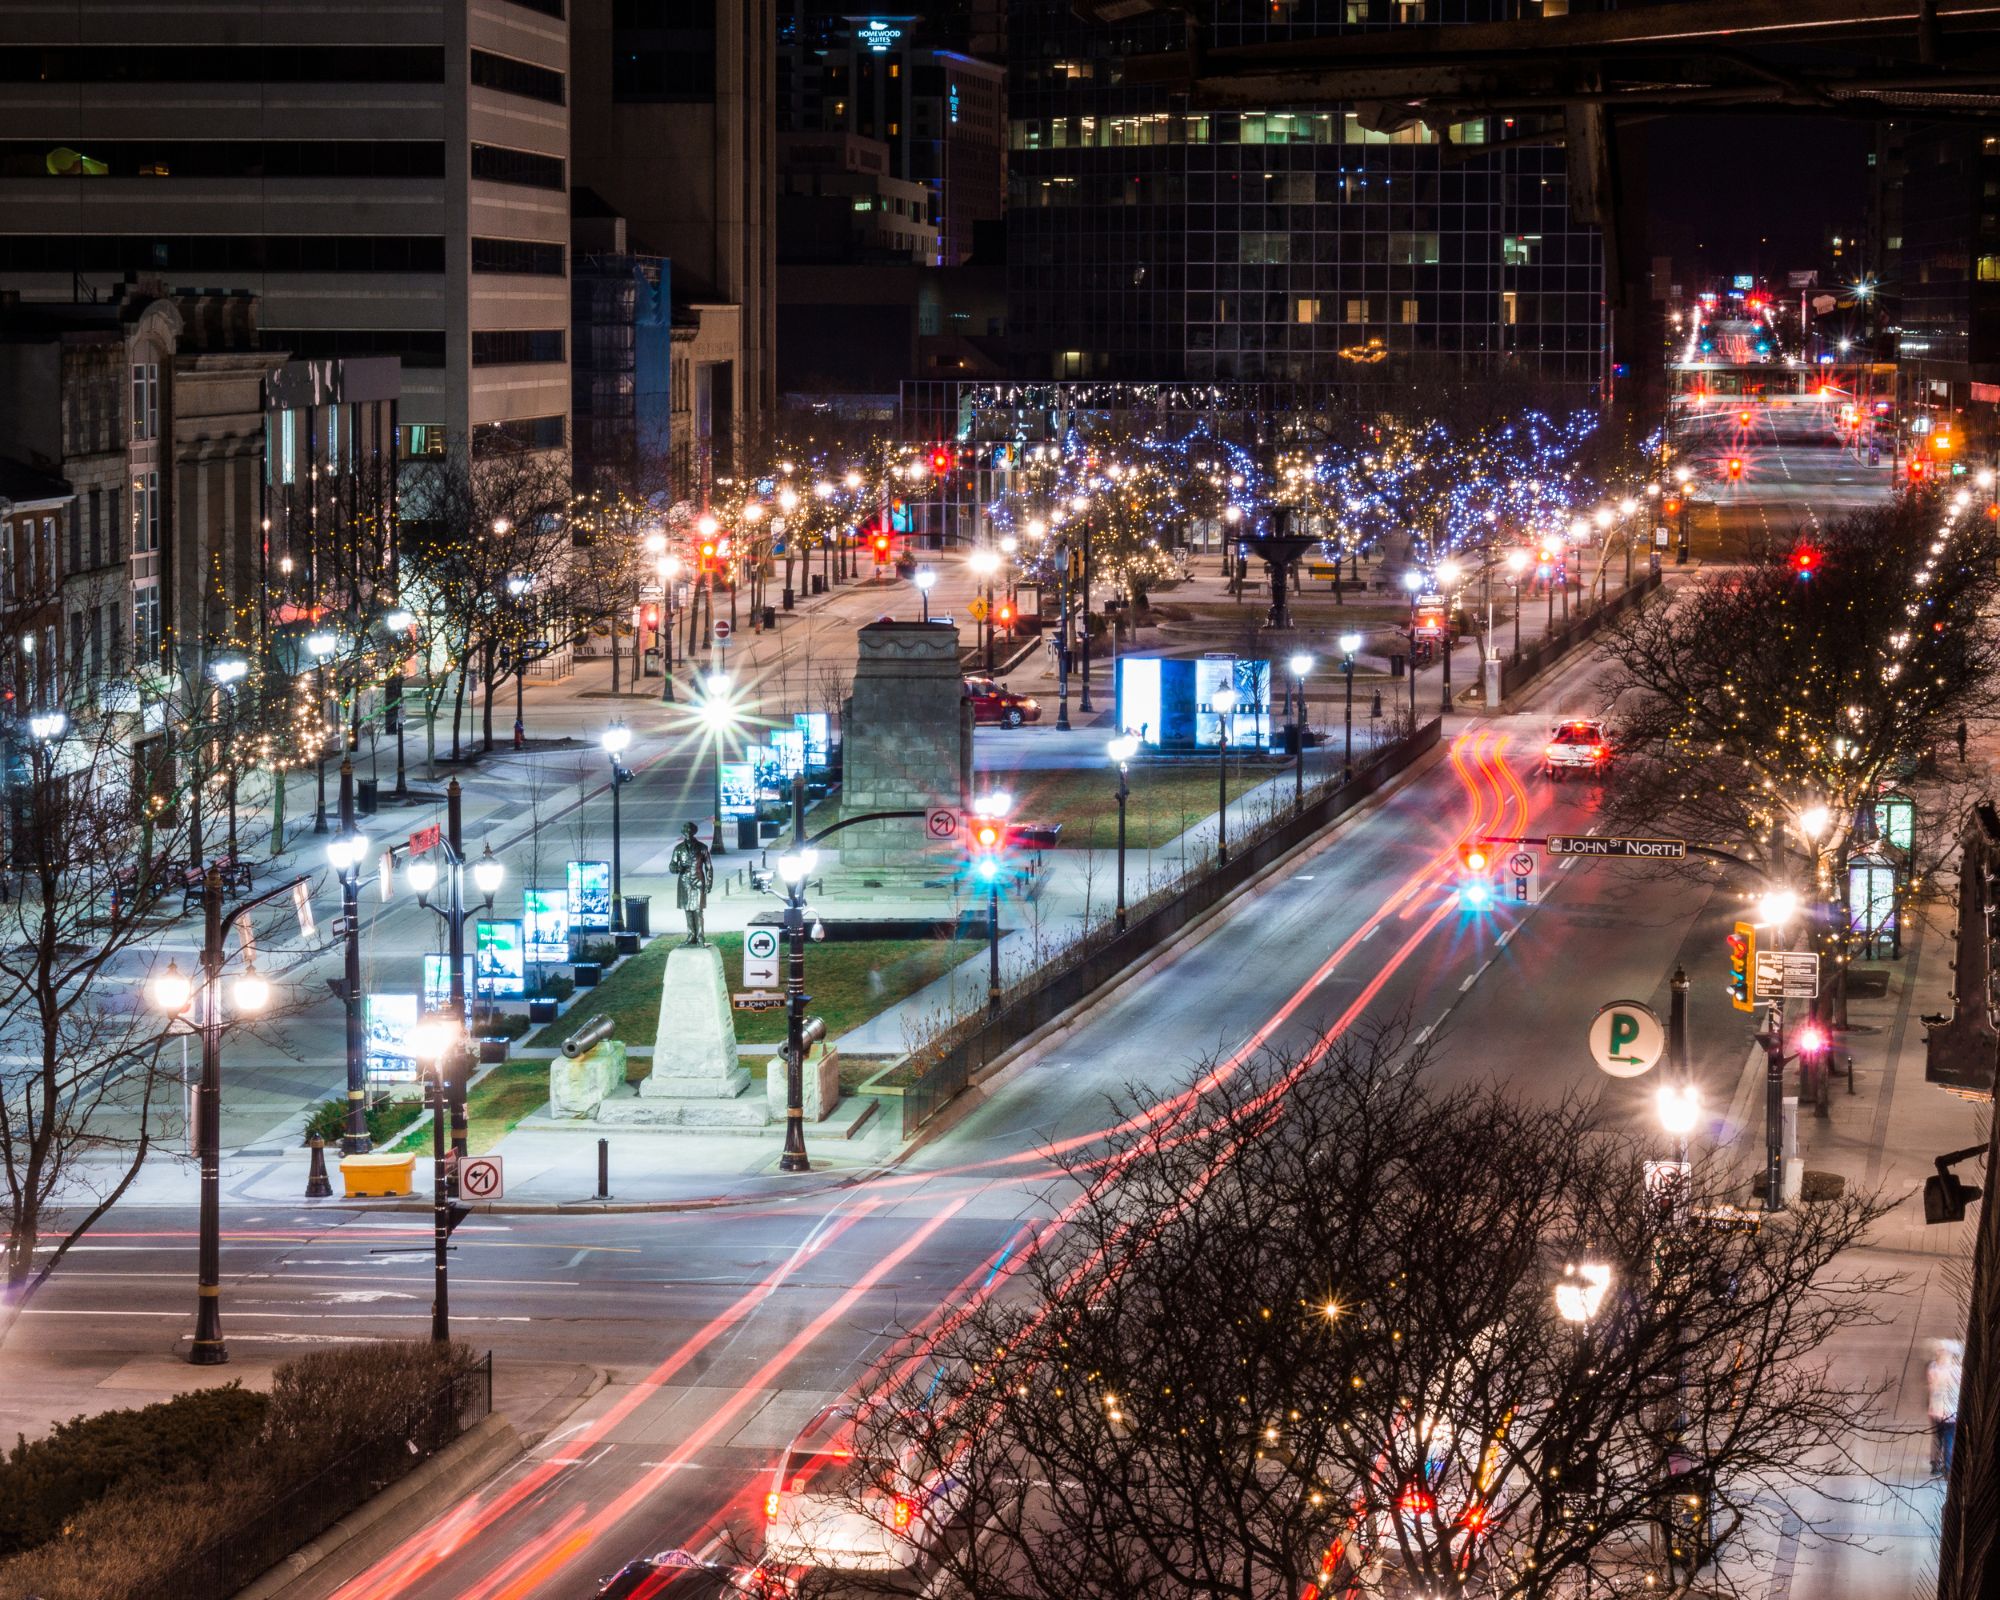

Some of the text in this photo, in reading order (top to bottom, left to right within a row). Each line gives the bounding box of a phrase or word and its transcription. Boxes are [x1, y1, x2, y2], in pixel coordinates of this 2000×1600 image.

[858, 30, 901, 38] HOMEWOOD
[1563, 839, 1608, 854] JOHN
[1626, 841, 1683, 857] NORTH
[1610, 1013, 1640, 1055] P
